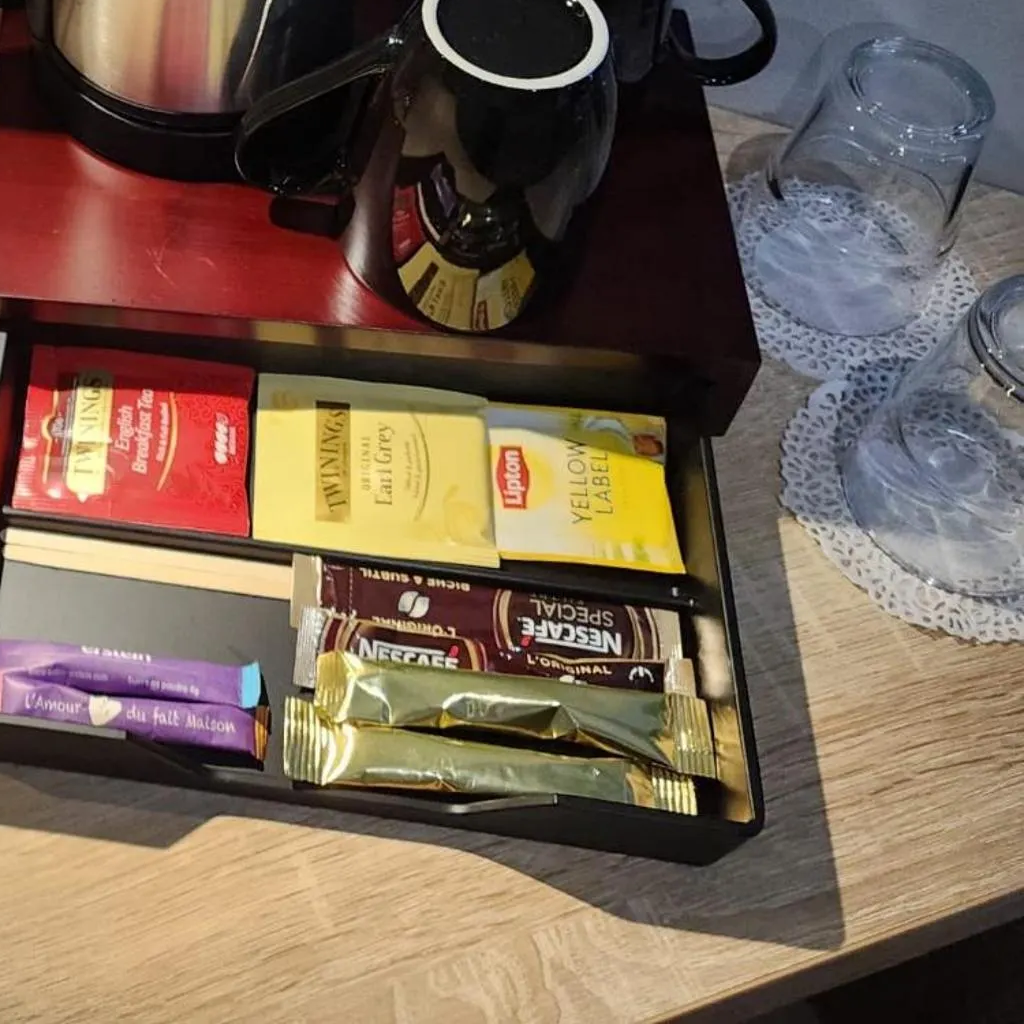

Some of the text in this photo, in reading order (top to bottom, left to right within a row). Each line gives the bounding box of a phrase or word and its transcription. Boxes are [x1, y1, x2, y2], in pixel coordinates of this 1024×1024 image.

[114, 404, 135, 451] English
[132, 410, 153, 474] Breakfast
[320, 409, 348, 512] TWININGS
[374, 422, 396, 505] Earl Grey
[504, 449, 528, 506] Lipton
[565, 437, 592, 524] YELLOW
[590, 452, 614, 515] LABEL
[529, 598, 615, 627] SPECIAL
[527, 655, 612, 675] L'ORIGINAL
[126, 704, 146, 722] du
[153, 706, 179, 727] fait
[185, 712, 236, 733] Maison
